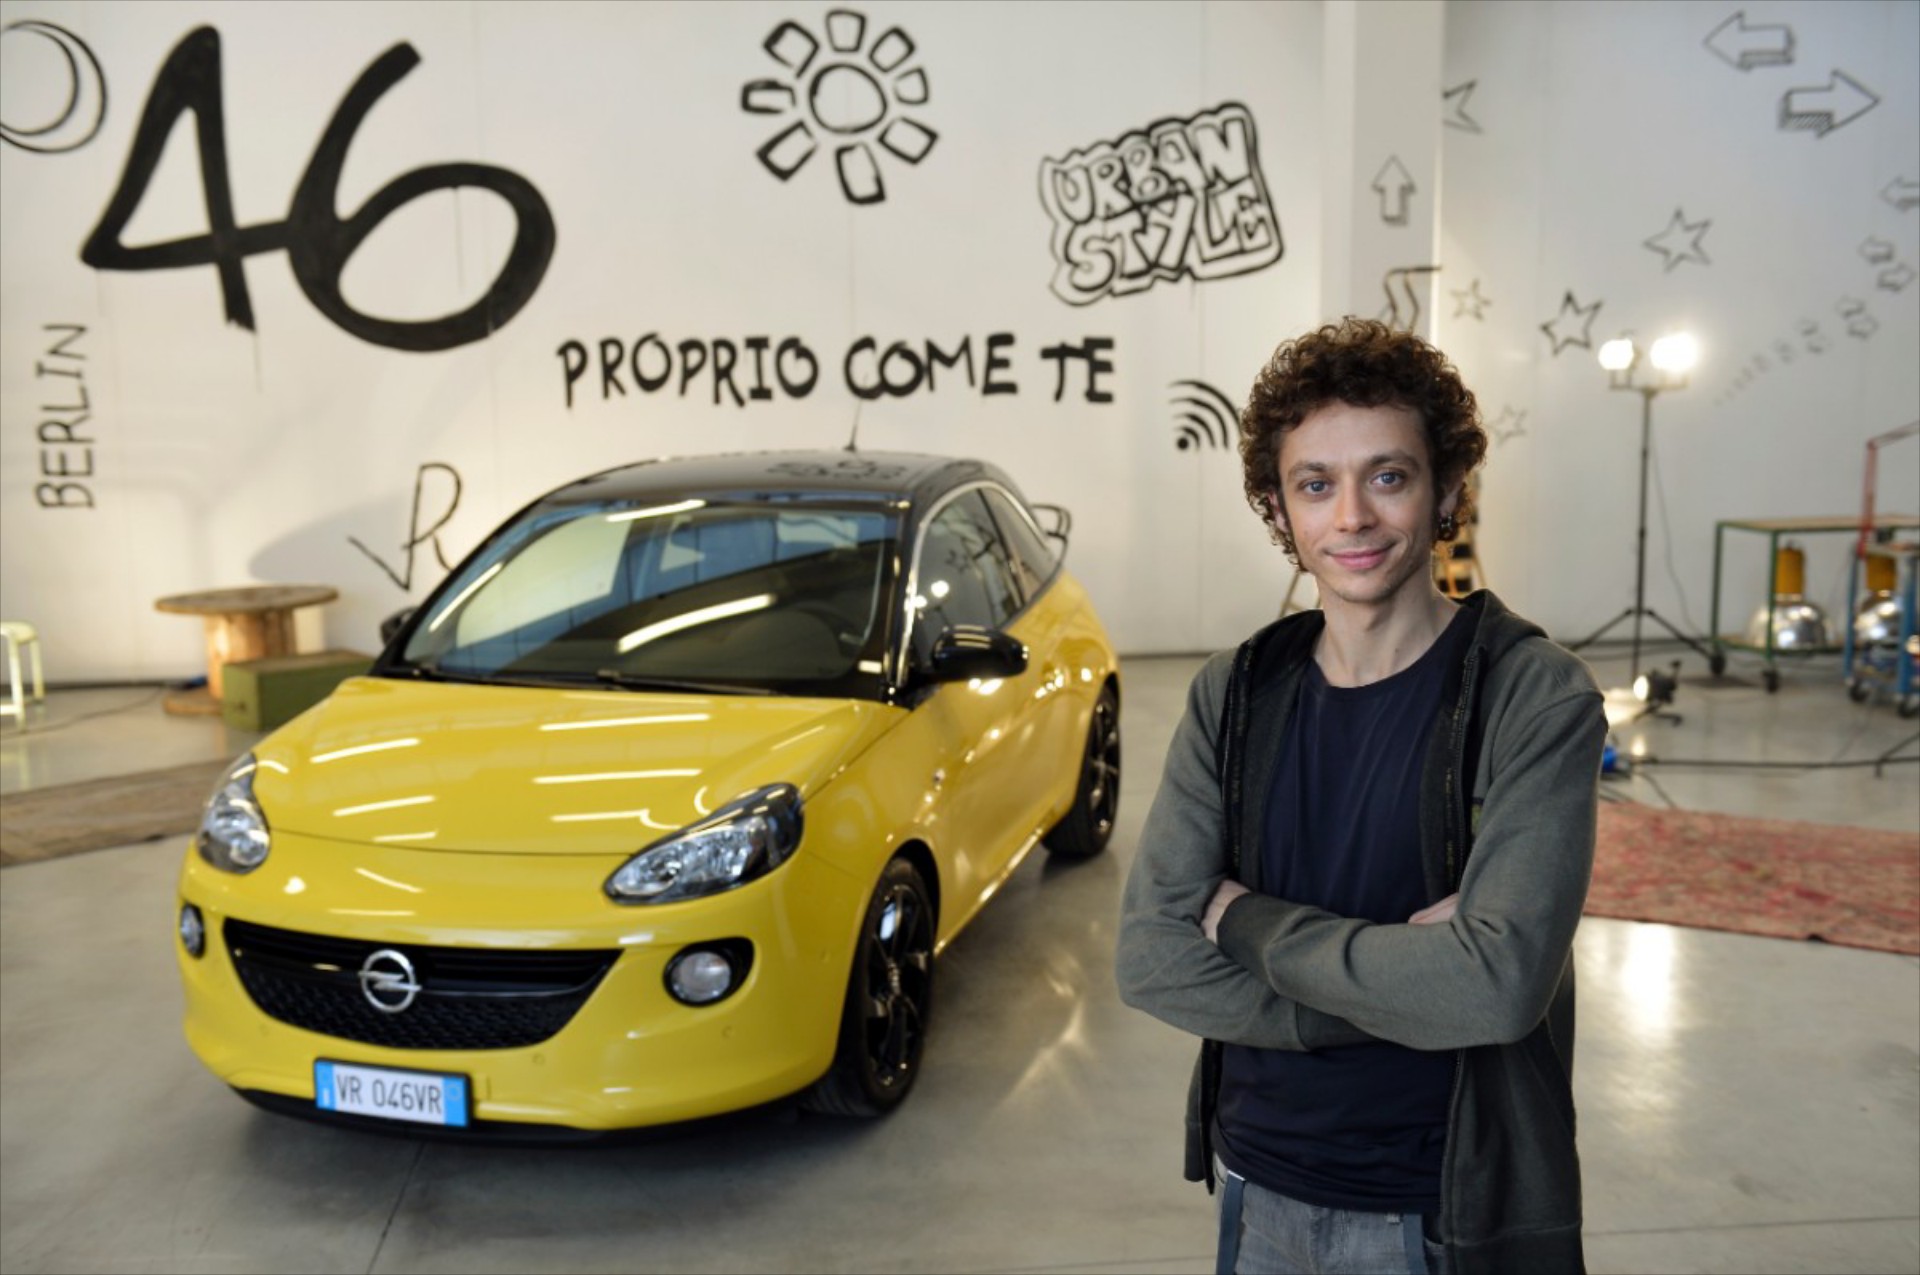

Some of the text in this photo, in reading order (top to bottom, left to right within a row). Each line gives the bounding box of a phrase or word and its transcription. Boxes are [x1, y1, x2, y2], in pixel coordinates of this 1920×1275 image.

[80, 23, 556, 352] 46
[1051, 116, 1251, 225] URBAN
[1064, 190, 1273, 293] STYLE
[35, 323, 94, 510] BERLIN
[556, 332, 1114, 408] PROPRIO COME TE
[347, 462, 462, 592] VR
[335, 1074, 362, 1105] VR
[371, 1079, 442, 1115] 046VR
